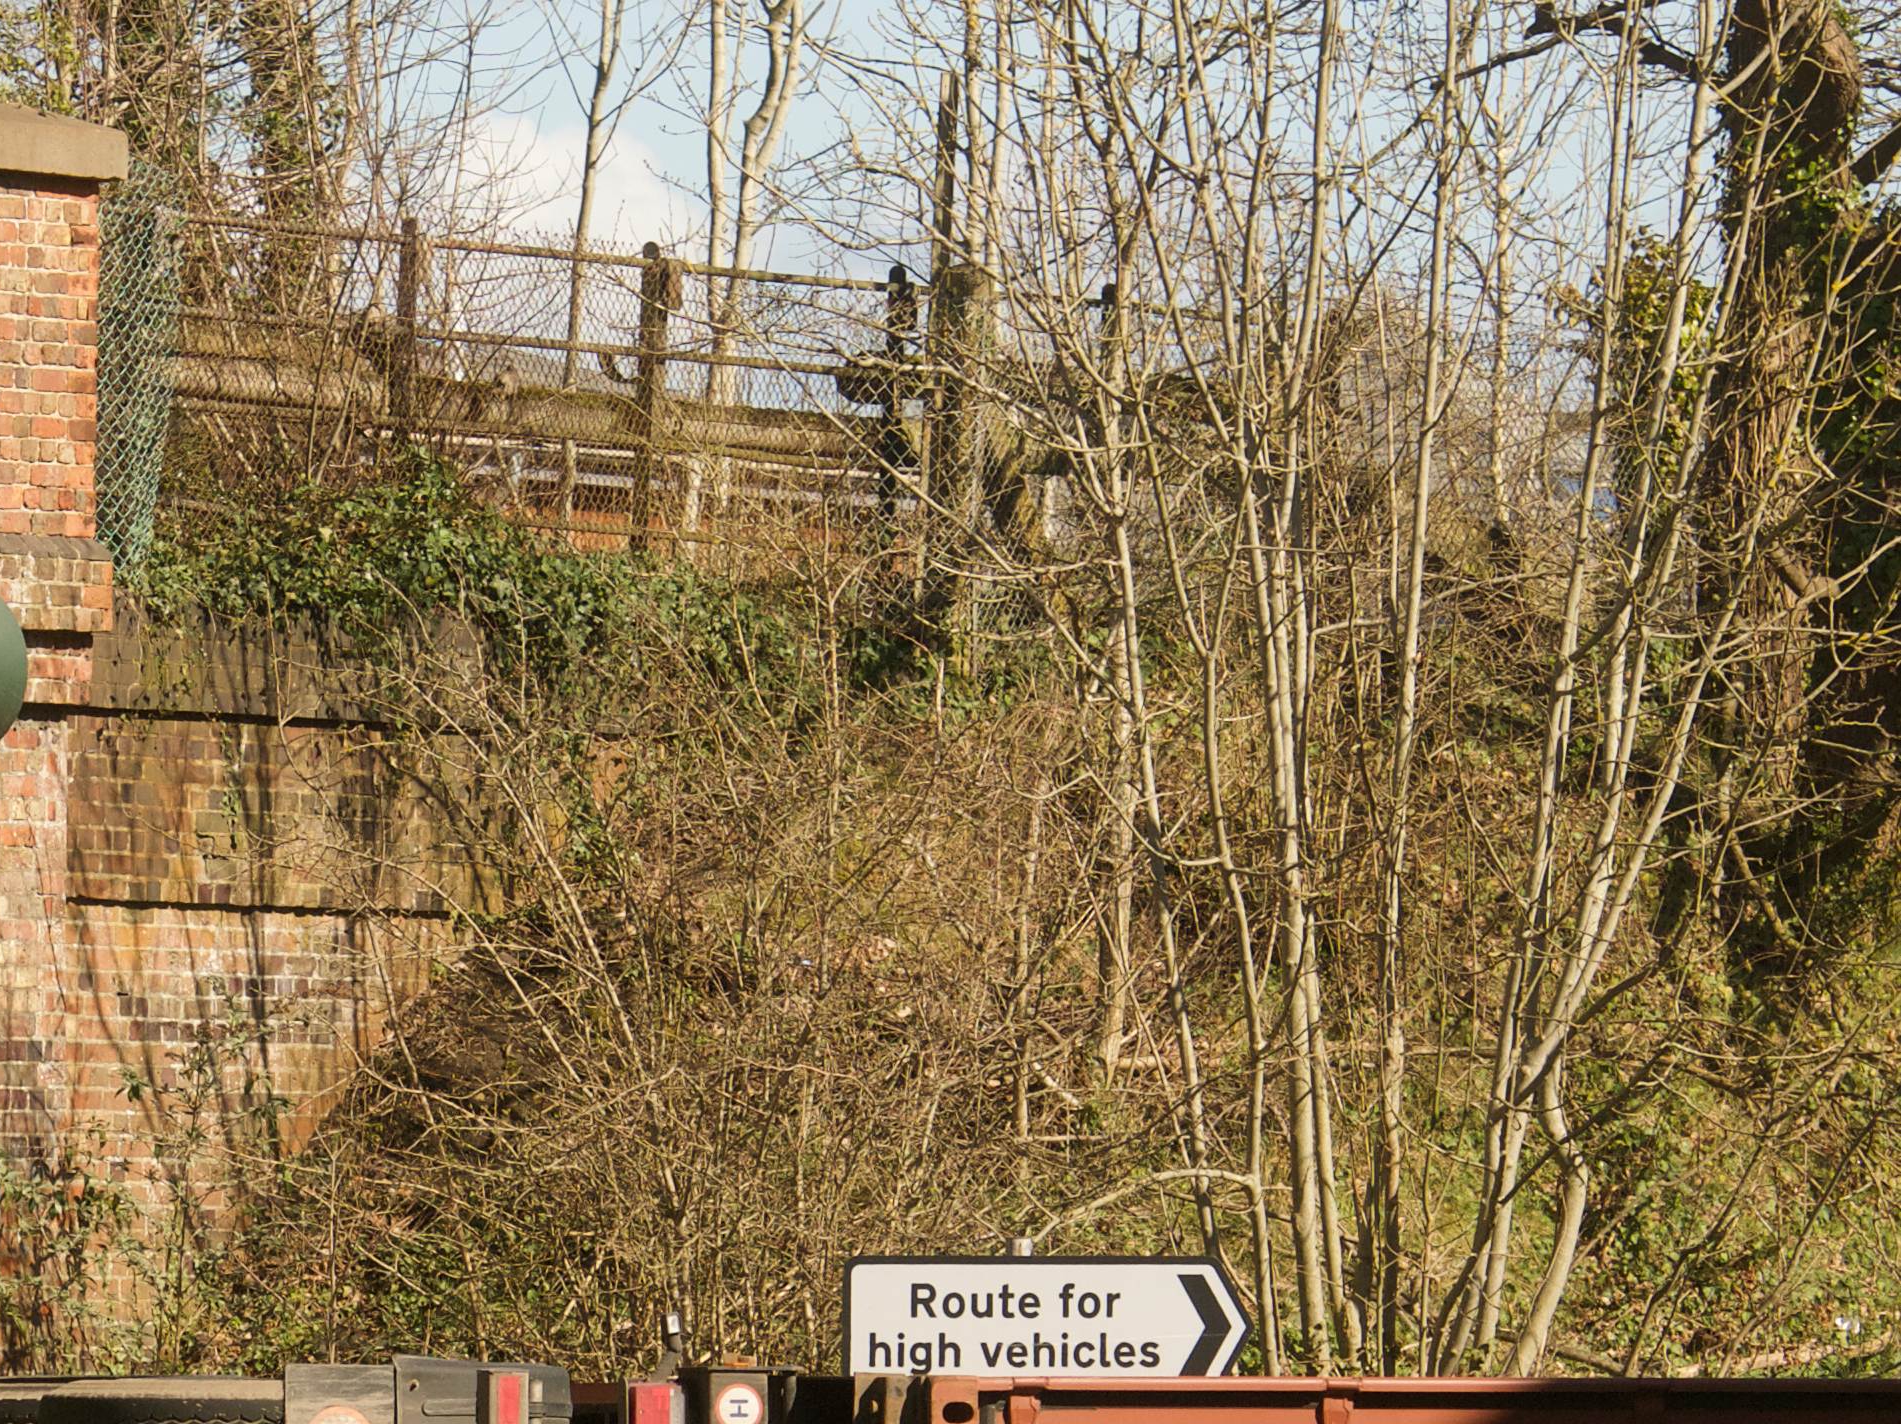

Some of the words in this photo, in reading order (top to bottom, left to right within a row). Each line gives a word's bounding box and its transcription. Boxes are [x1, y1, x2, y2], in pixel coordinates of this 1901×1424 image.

[910, 1283, 1041, 1319] Route
[1059, 1283, 1121, 1319] for
[868, 1332, 961, 1374] high
[981, 1332, 1161, 1369] vehicles
